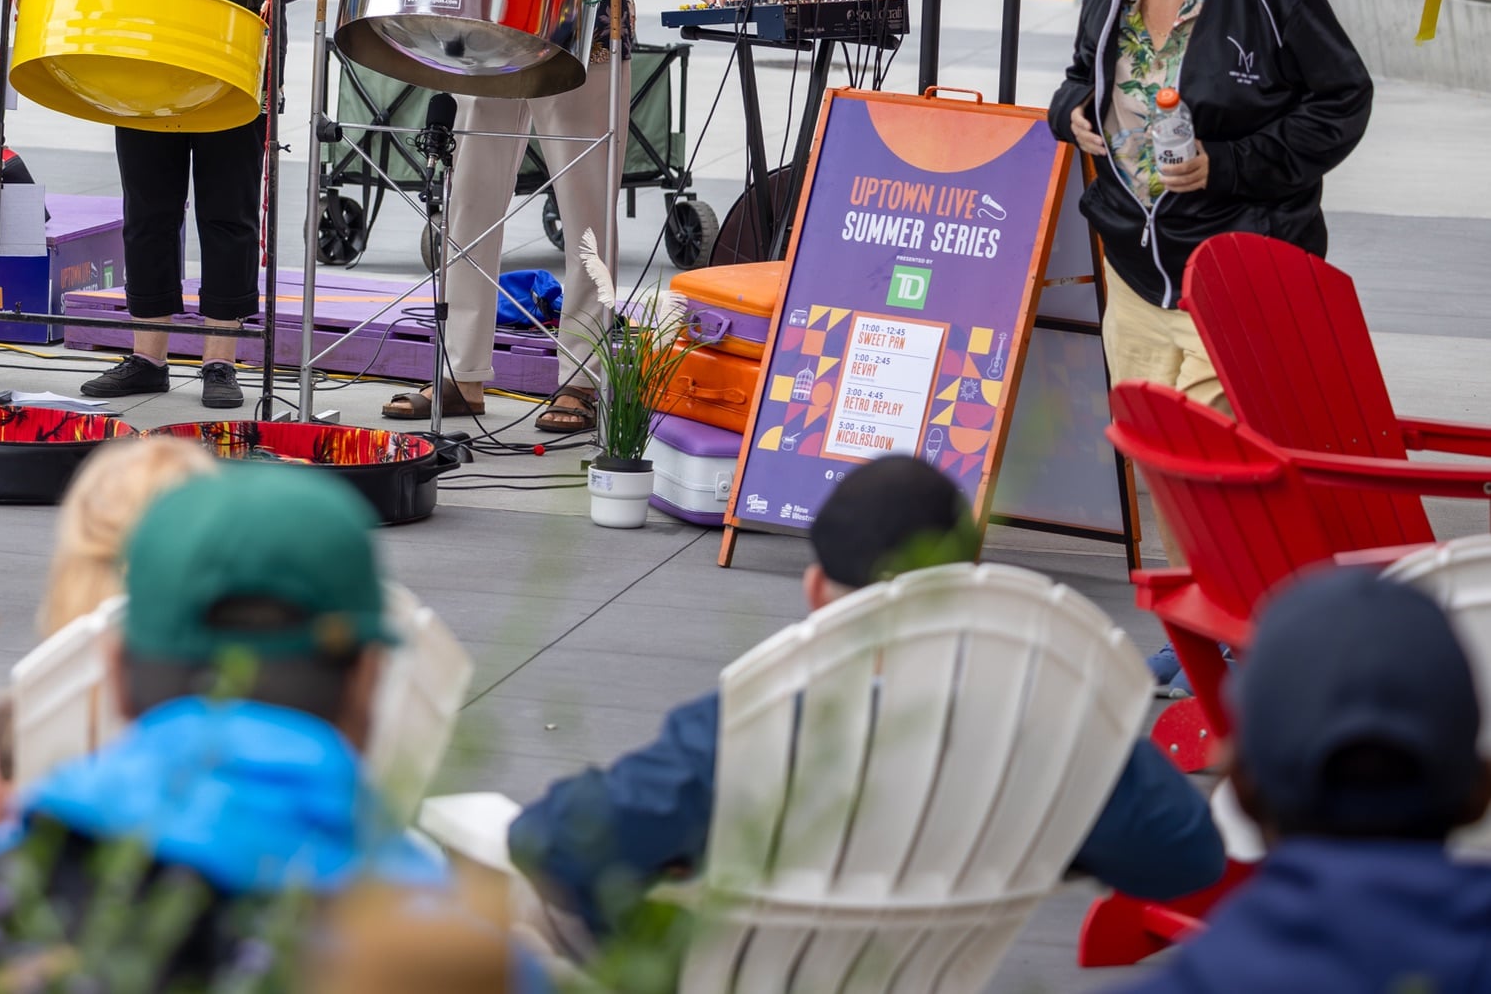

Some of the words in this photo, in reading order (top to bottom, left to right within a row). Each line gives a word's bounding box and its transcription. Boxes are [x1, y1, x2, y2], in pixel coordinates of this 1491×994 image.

[850, 176, 935, 214] UPTOWN
[936, 186, 979, 219] LIVE
[841, 211, 925, 249] SUMMER
[930, 221, 1001, 259] SERIES
[896, 273, 925, 300] TD
[861, 323, 880, 332] 11:00
[886, 326, 906, 336] 12:45
[858, 331, 887, 347] SWEET
[888, 335, 906, 350] PAN
[854, 353, 870, 362] 1:00
[875, 356, 891, 365] 2:45
[851, 362, 878, 377] REVAY
[846, 387, 862, 397] 3:00
[868, 391, 884, 399] 4:45
[843, 395, 870, 412] RETRO
[872, 400, 904, 417] REPLAY
[839, 421, 855, 430] 5:00
[860, 425, 876, 434] 6:30
[793, 505, 809, 514] New
